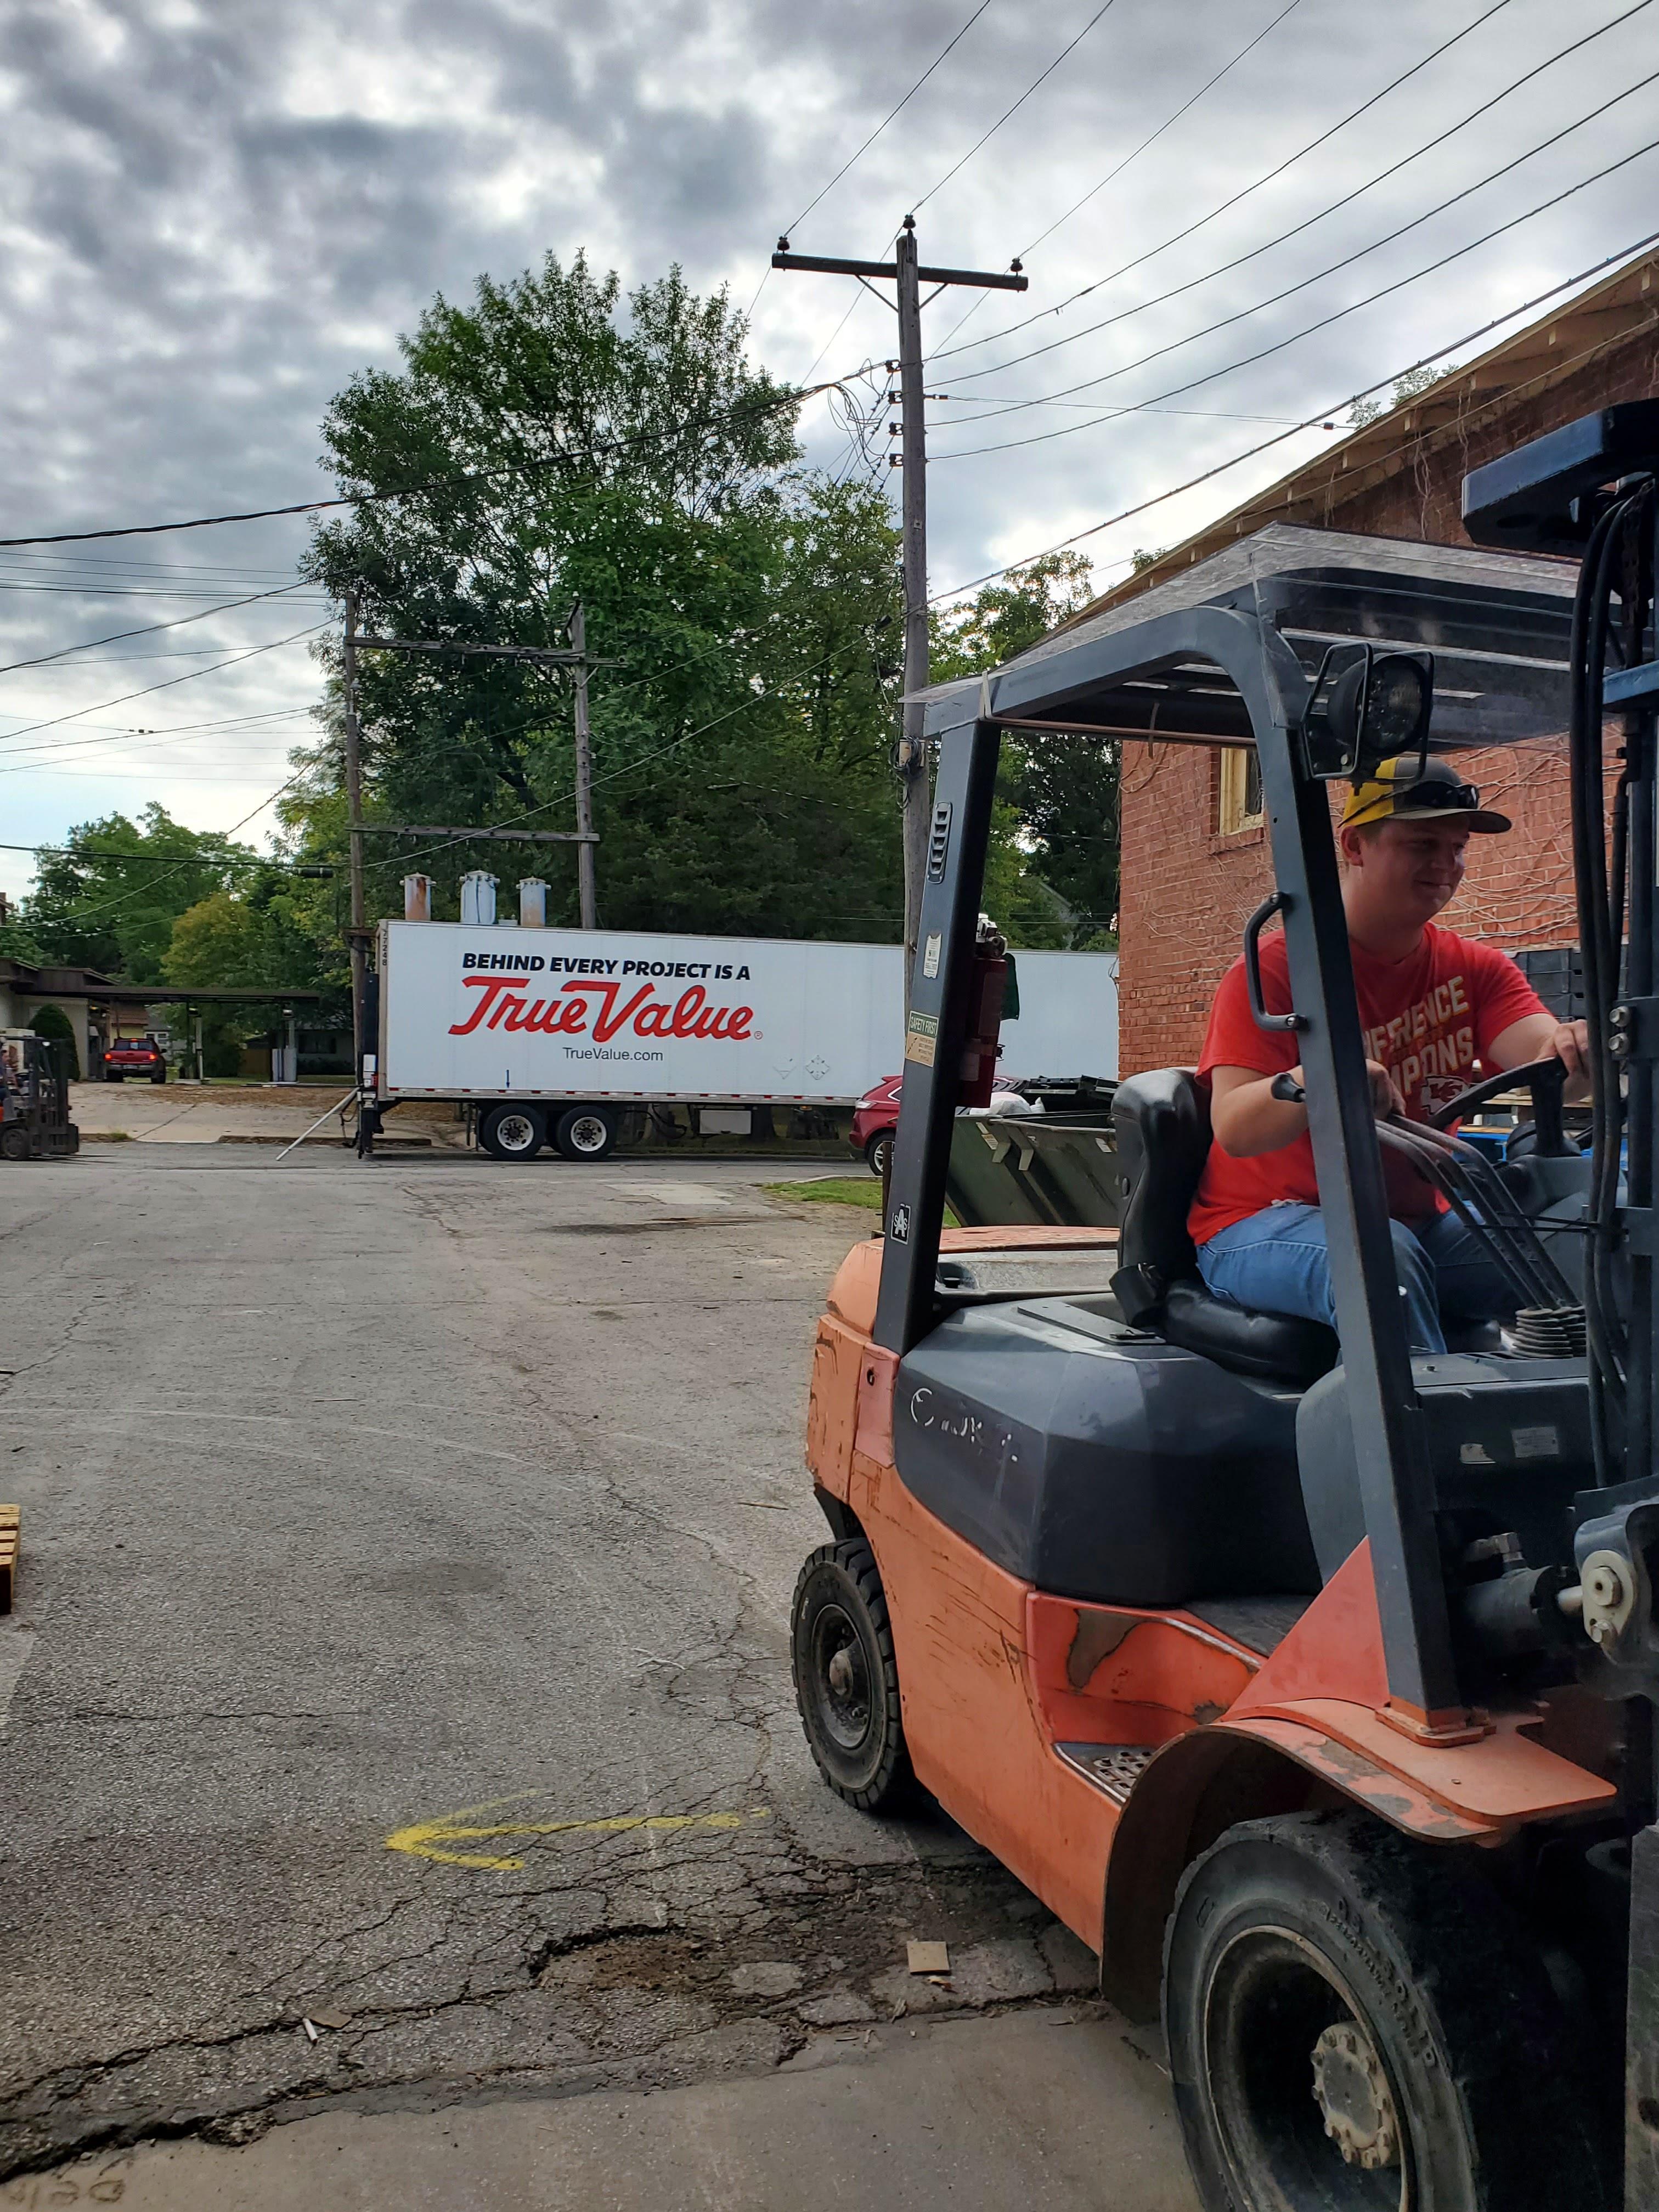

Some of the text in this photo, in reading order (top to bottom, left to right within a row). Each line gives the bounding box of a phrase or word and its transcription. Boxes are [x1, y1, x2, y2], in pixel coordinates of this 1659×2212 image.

[462, 953, 751, 980] BEHIND EVERY PROJECT IS A
[448, 975, 754, 1042] True Value
[911, 1016, 936, 1035] SAFETY FIRST
[562, 1047, 663, 1062] TrueValue.com
